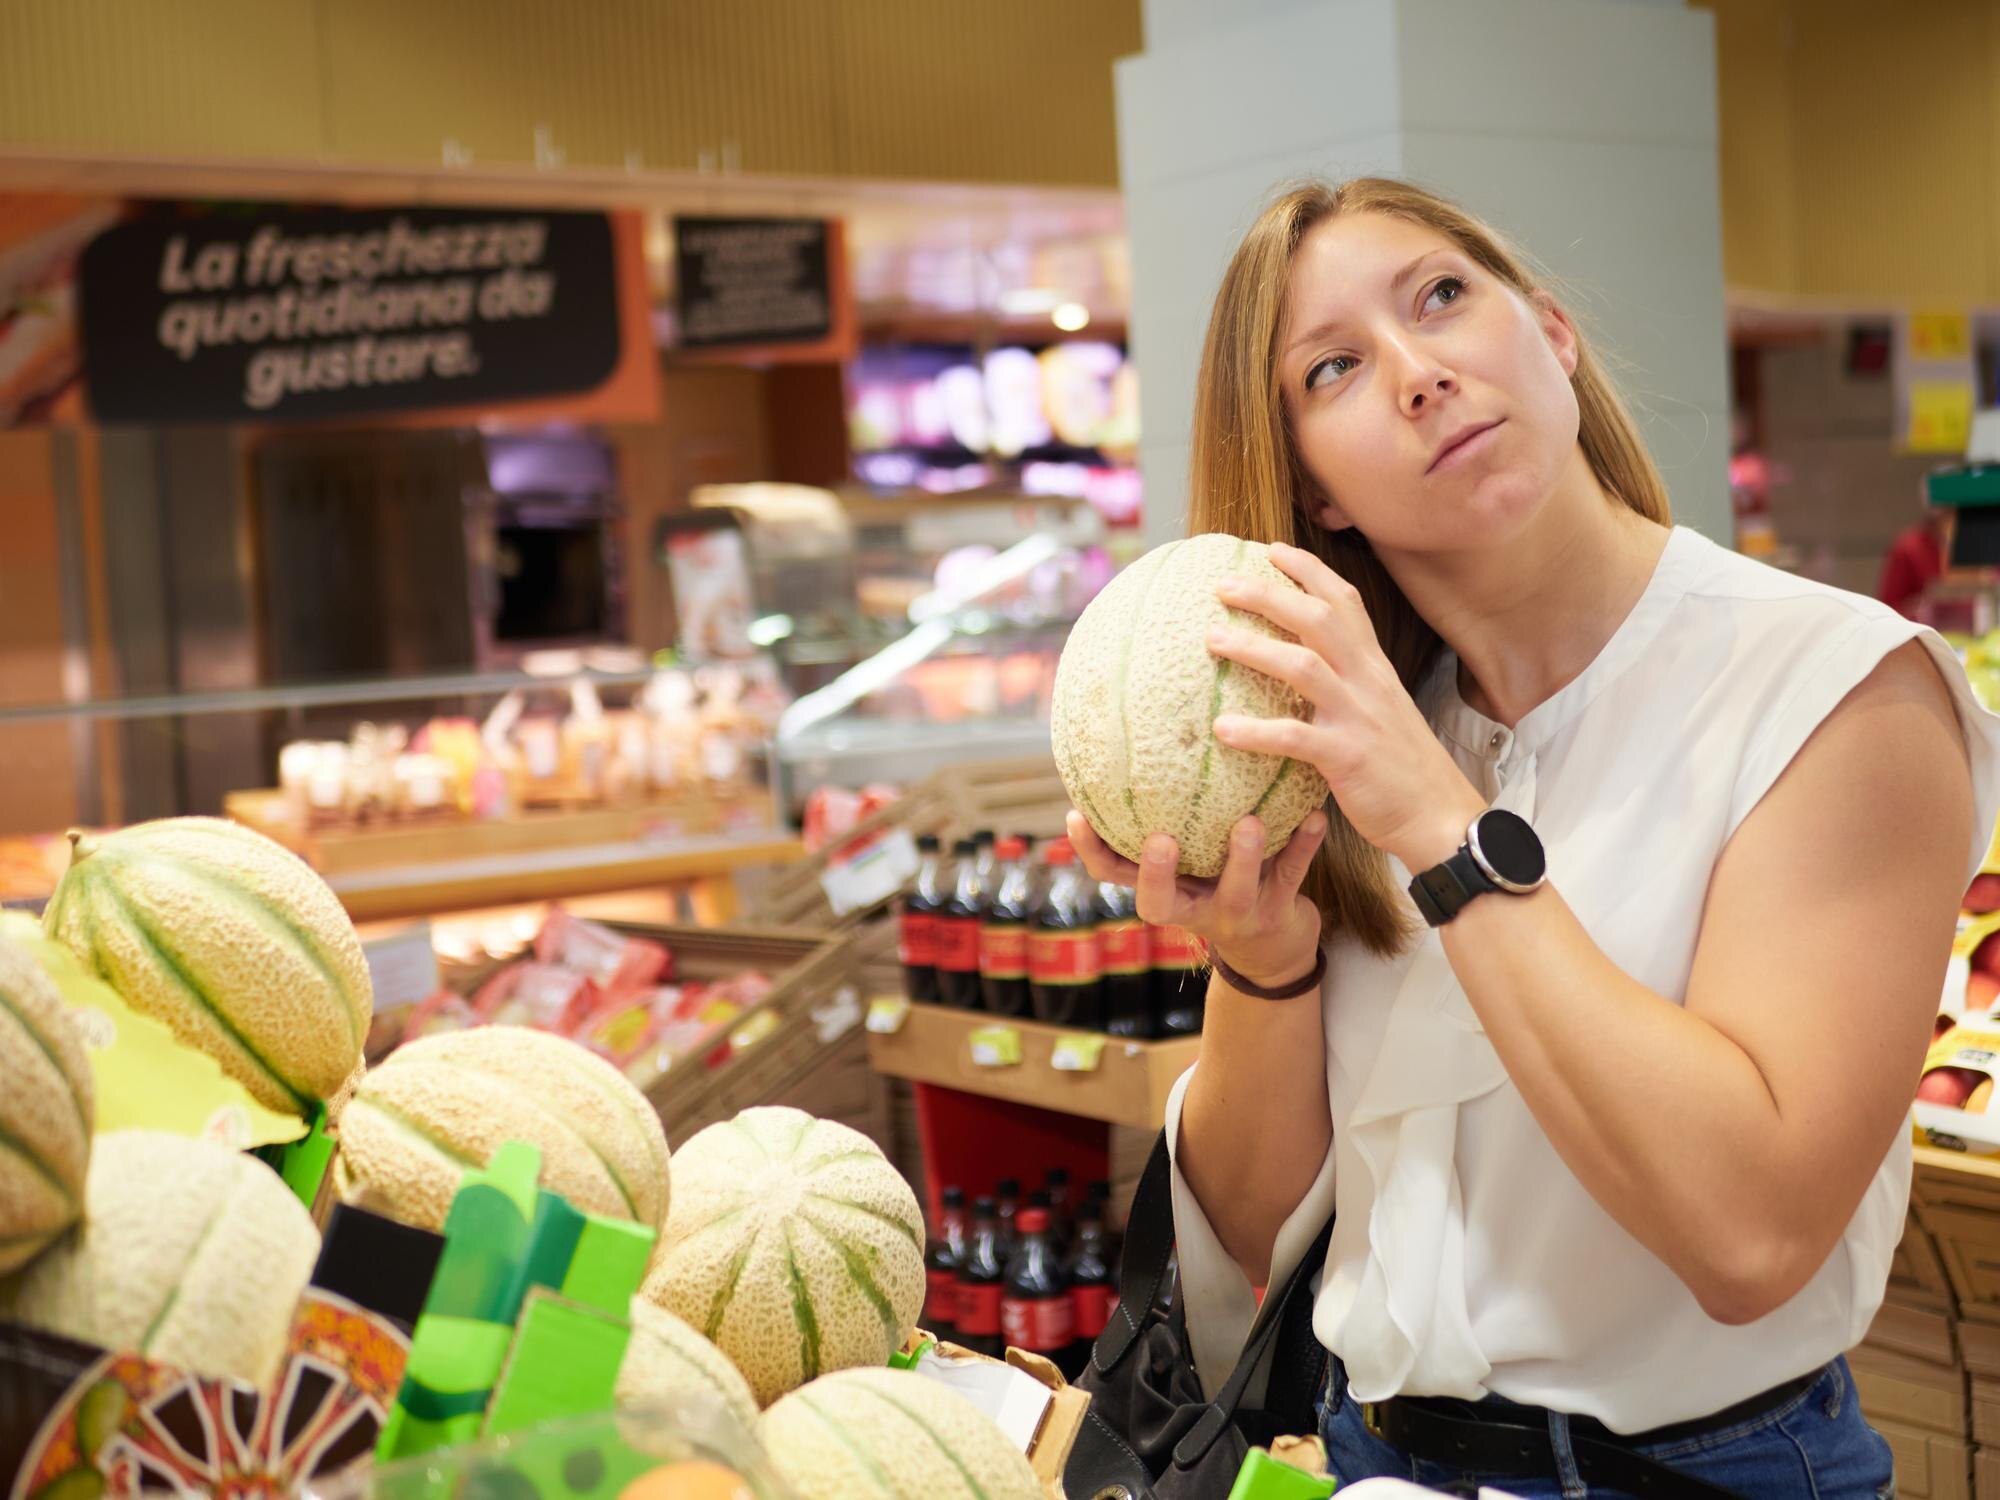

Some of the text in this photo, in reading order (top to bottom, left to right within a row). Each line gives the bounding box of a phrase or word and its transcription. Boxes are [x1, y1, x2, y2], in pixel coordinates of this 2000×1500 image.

[160, 217, 547, 291] La freschezza
[159, 268, 553, 361] quotidiana da
[244, 332, 479, 408] gustare.
